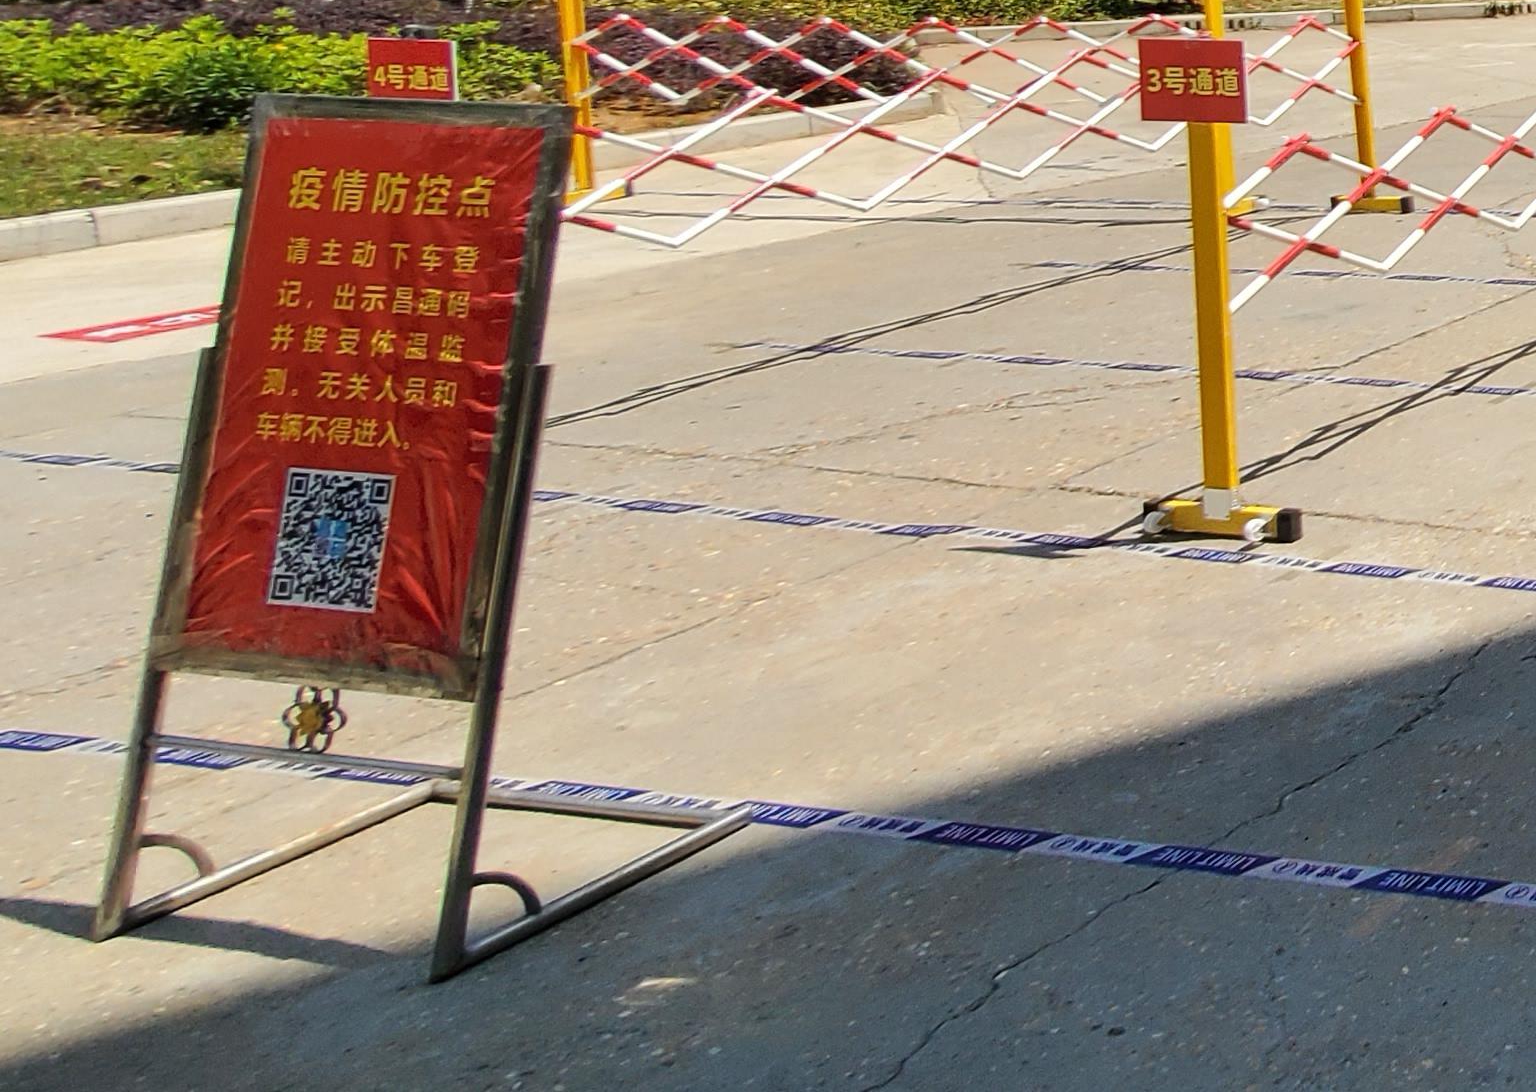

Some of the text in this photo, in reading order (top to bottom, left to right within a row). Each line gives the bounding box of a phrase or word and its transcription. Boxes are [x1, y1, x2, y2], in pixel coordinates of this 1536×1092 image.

[373, 64, 451, 92] 4号通道
[1146, 67, 1240, 97] 3号通道
[288, 166, 495, 218] 疫情防控点
[285, 236, 480, 276] 请主动下车登
[256, 411, 412, 451] 车辆不得进入。
[938, 825, 1037, 846] LIMIT LINE
[1159, 848, 1258, 871] LIMIT LINE
[1381, 871, 1487, 896] LIMIT LINE
